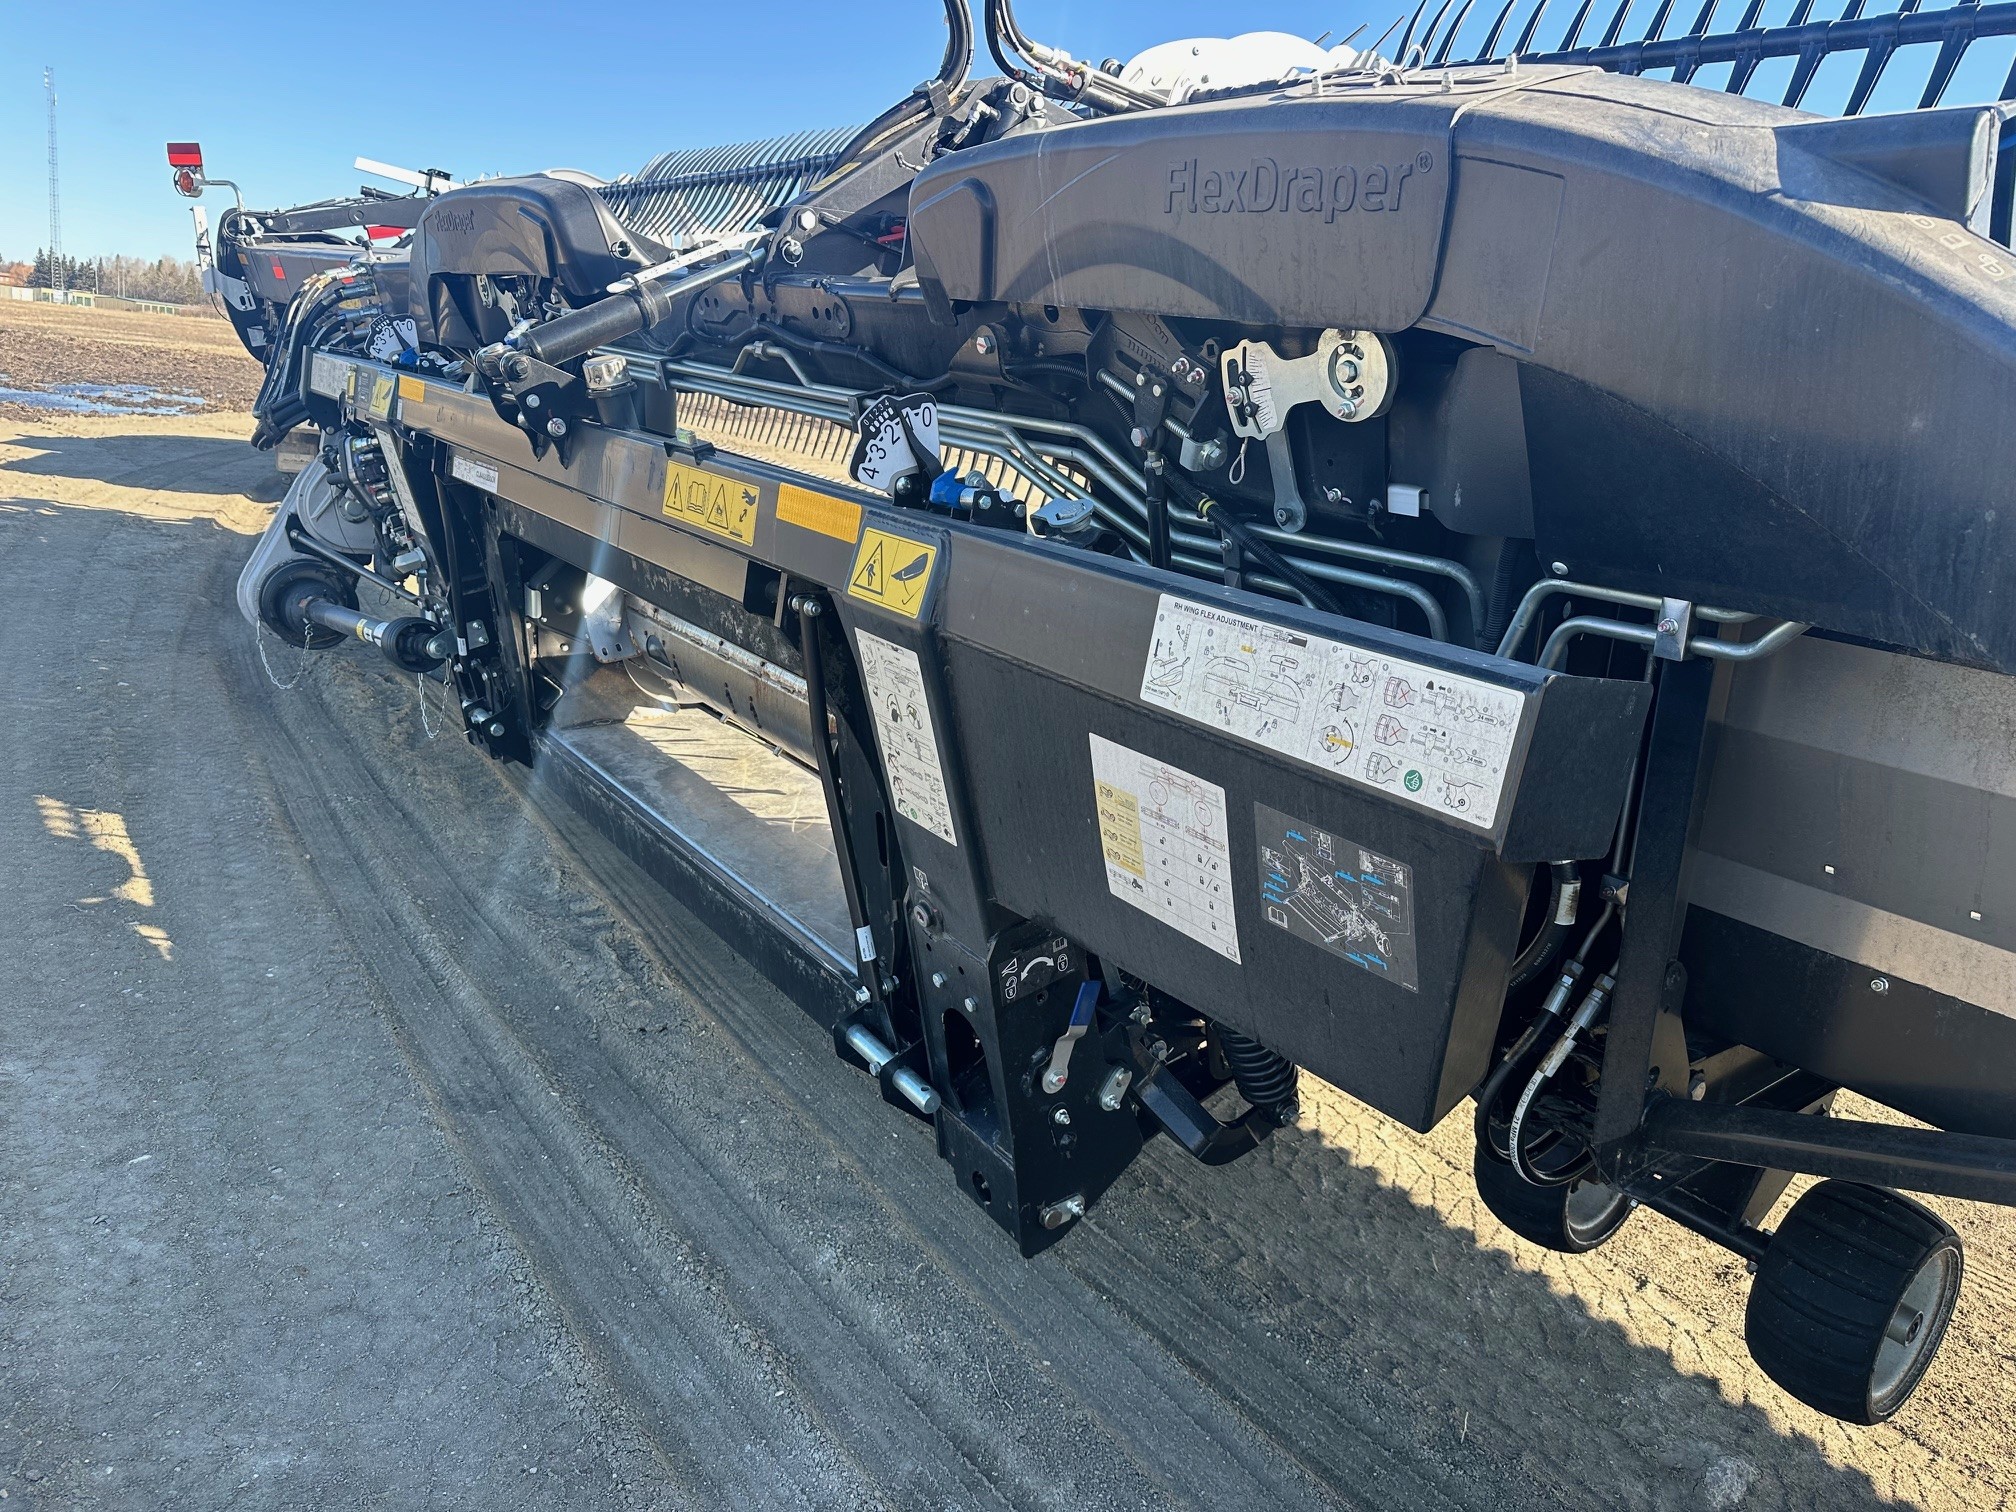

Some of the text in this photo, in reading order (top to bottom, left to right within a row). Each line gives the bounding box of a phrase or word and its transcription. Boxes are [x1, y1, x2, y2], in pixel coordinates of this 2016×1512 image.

[406, 320, 413, 331] 0
[384, 327, 395, 338] 2
[376, 336, 387, 345] 3
[372, 347, 383, 355] 4
[922, 406, 932, 427] 0
[884, 424, 900, 445] 2
[869, 443, 887, 460] 3
[861, 466, 880, 480] 4
[1173, 602, 1259, 632] RH WING FLEX ADJUSTMENT
[1514, 1115, 1520, 1125] 21
